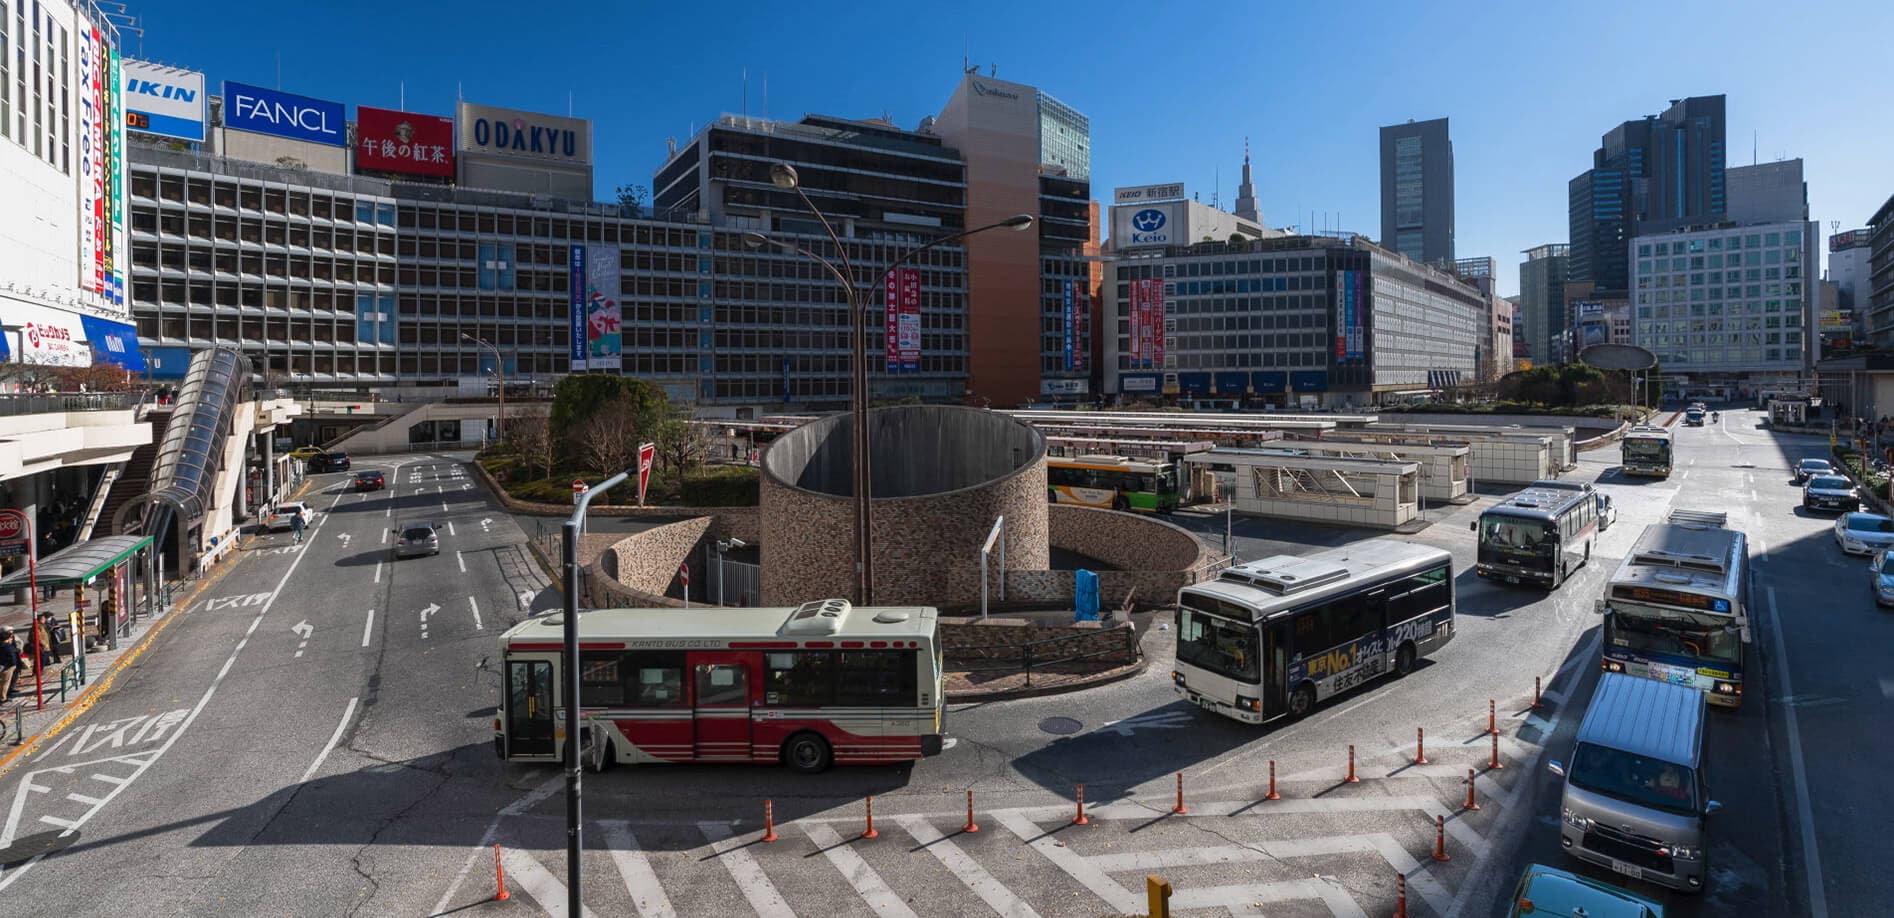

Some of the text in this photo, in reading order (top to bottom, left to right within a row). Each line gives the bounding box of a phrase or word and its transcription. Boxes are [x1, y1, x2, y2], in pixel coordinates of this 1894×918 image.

[81, 28, 93, 177] Tax Free
[235, 94, 337, 135] FANCL
[474, 117, 576, 157] ODAKYU
[362, 136, 445, 164] 午後の紅茶
[1119, 190, 1142, 199] KEIO
[1146, 185, 1180, 198] 新宿駅
[1132, 232, 1167, 244] Keio
[632, 640, 663, 648] KANTO
[664, 640, 686, 648] BUS
